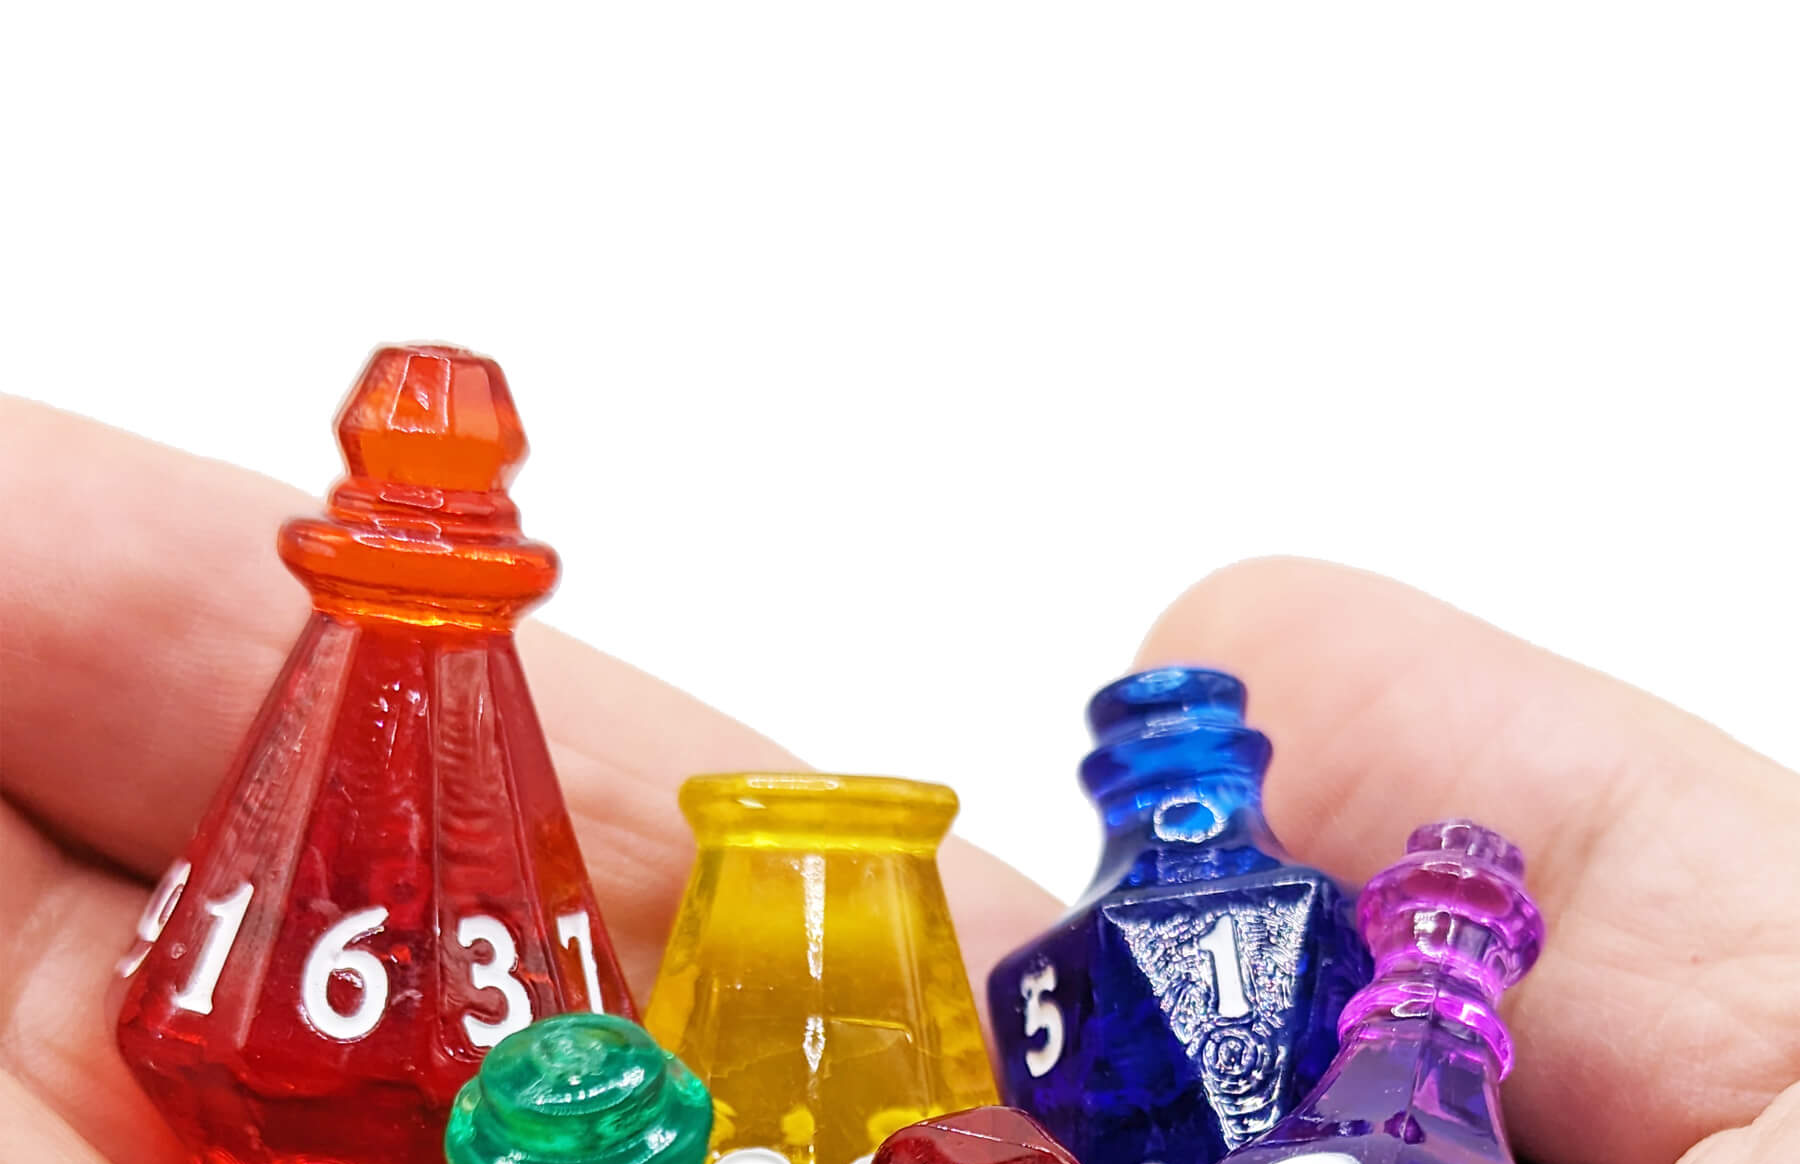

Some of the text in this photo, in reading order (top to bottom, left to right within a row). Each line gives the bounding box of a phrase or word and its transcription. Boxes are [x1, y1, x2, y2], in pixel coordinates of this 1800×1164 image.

[170, 880, 255, 1015] 1
[297, 906, 390, 1042] 6
[456, 914, 534, 1048] 3
[1021, 960, 1065, 1078] 5
[1199, 913, 1252, 1020] 1
